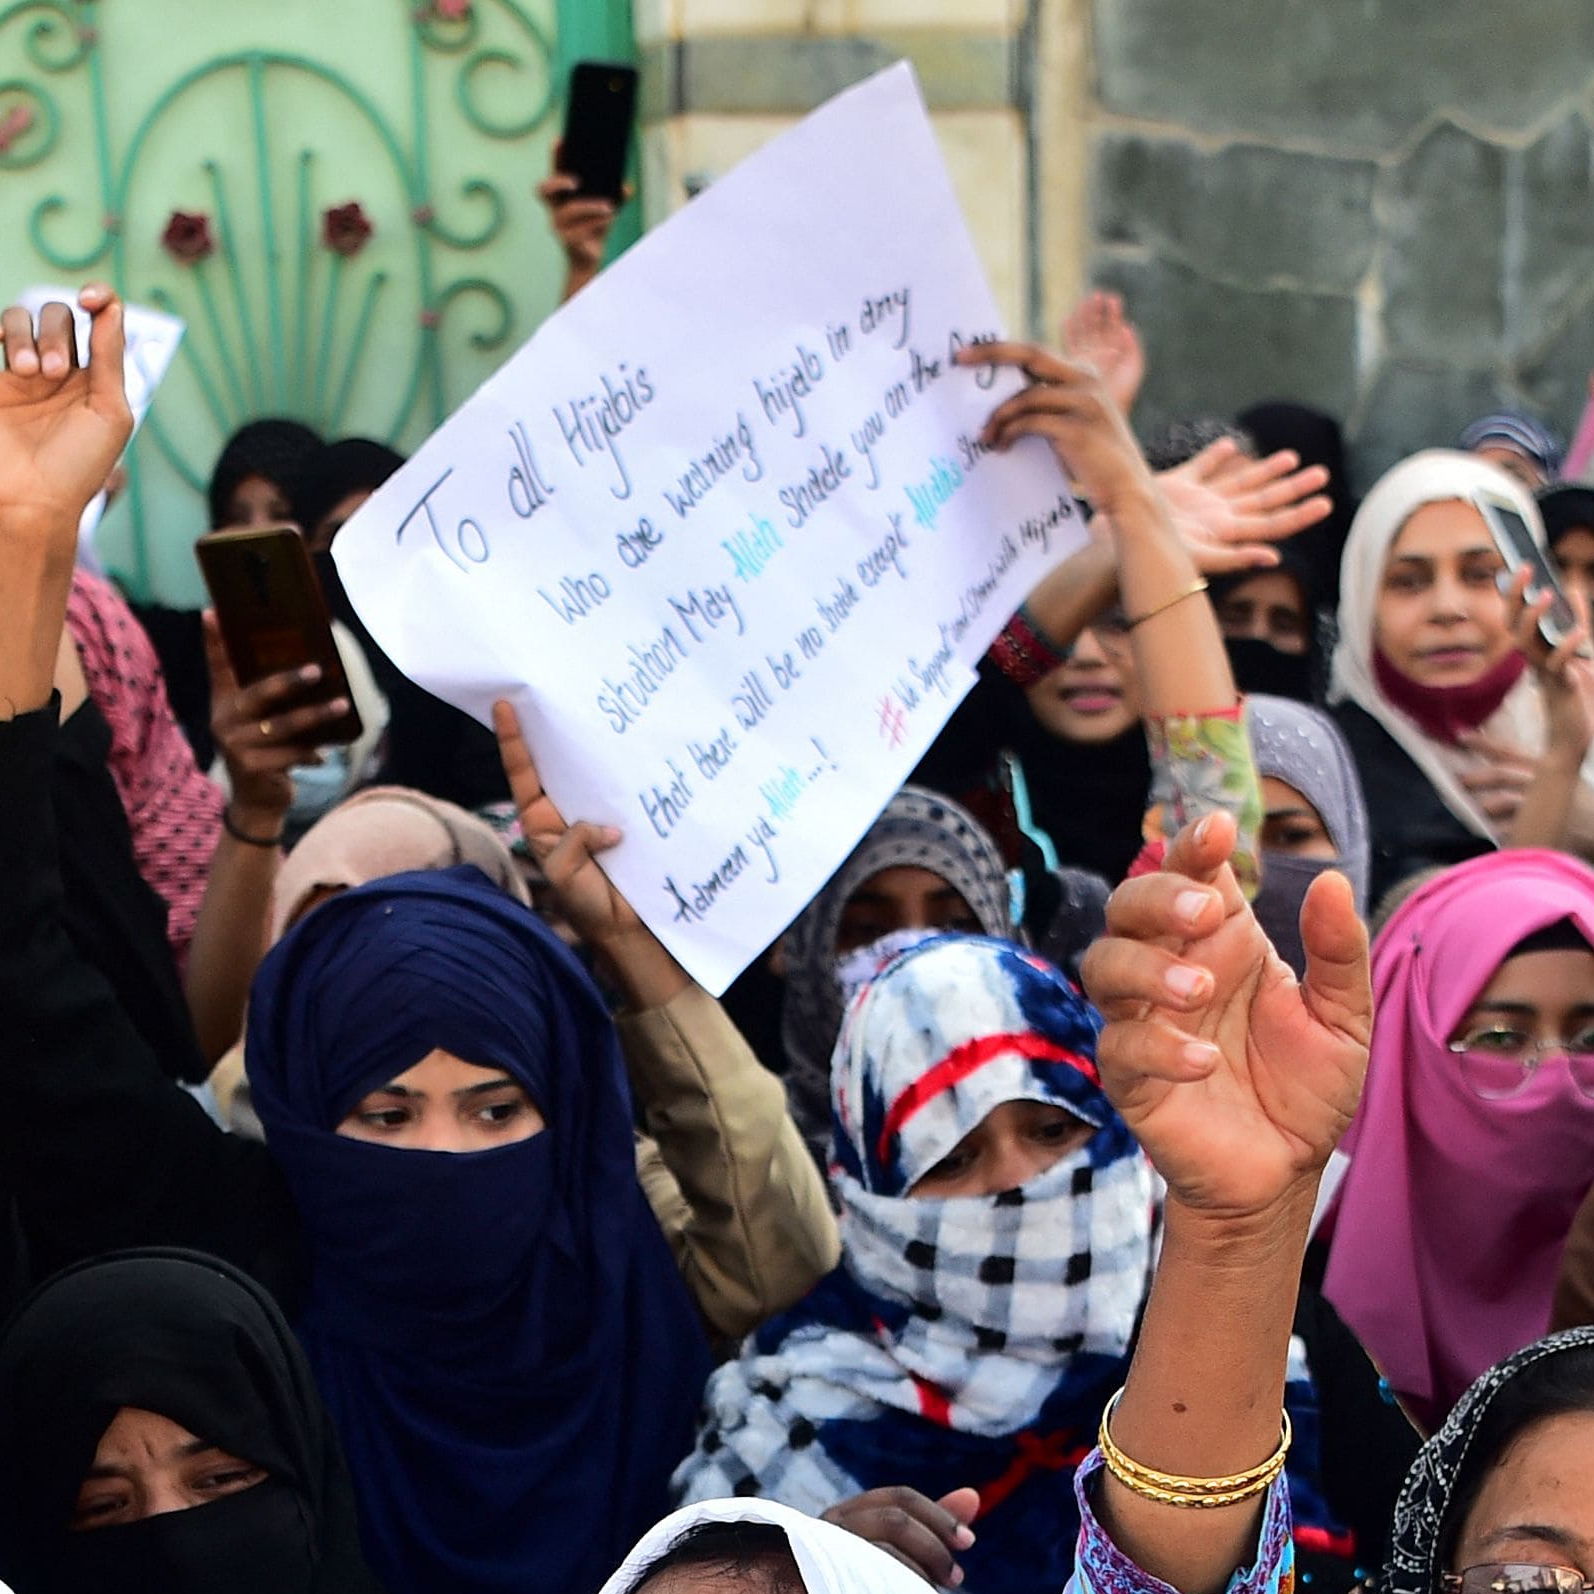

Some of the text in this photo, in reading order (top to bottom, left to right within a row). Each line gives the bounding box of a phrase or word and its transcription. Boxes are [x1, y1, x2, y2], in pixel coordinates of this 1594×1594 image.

[396, 363, 655, 573] To all Hijabis
[536, 288, 909, 625] Who are wearing hijab in any
[667, 584, 745, 643] May
[720, 512, 784, 583] Allah
[851, 412, 885, 490] you
[909, 349, 941, 393] the
[638, 759, 694, 839] that
[687, 727, 737, 780] there
[731, 670, 775, 732] will
[766, 653, 801, 690] be
[796, 626, 824, 660] no
[746, 815, 778, 884] ya
